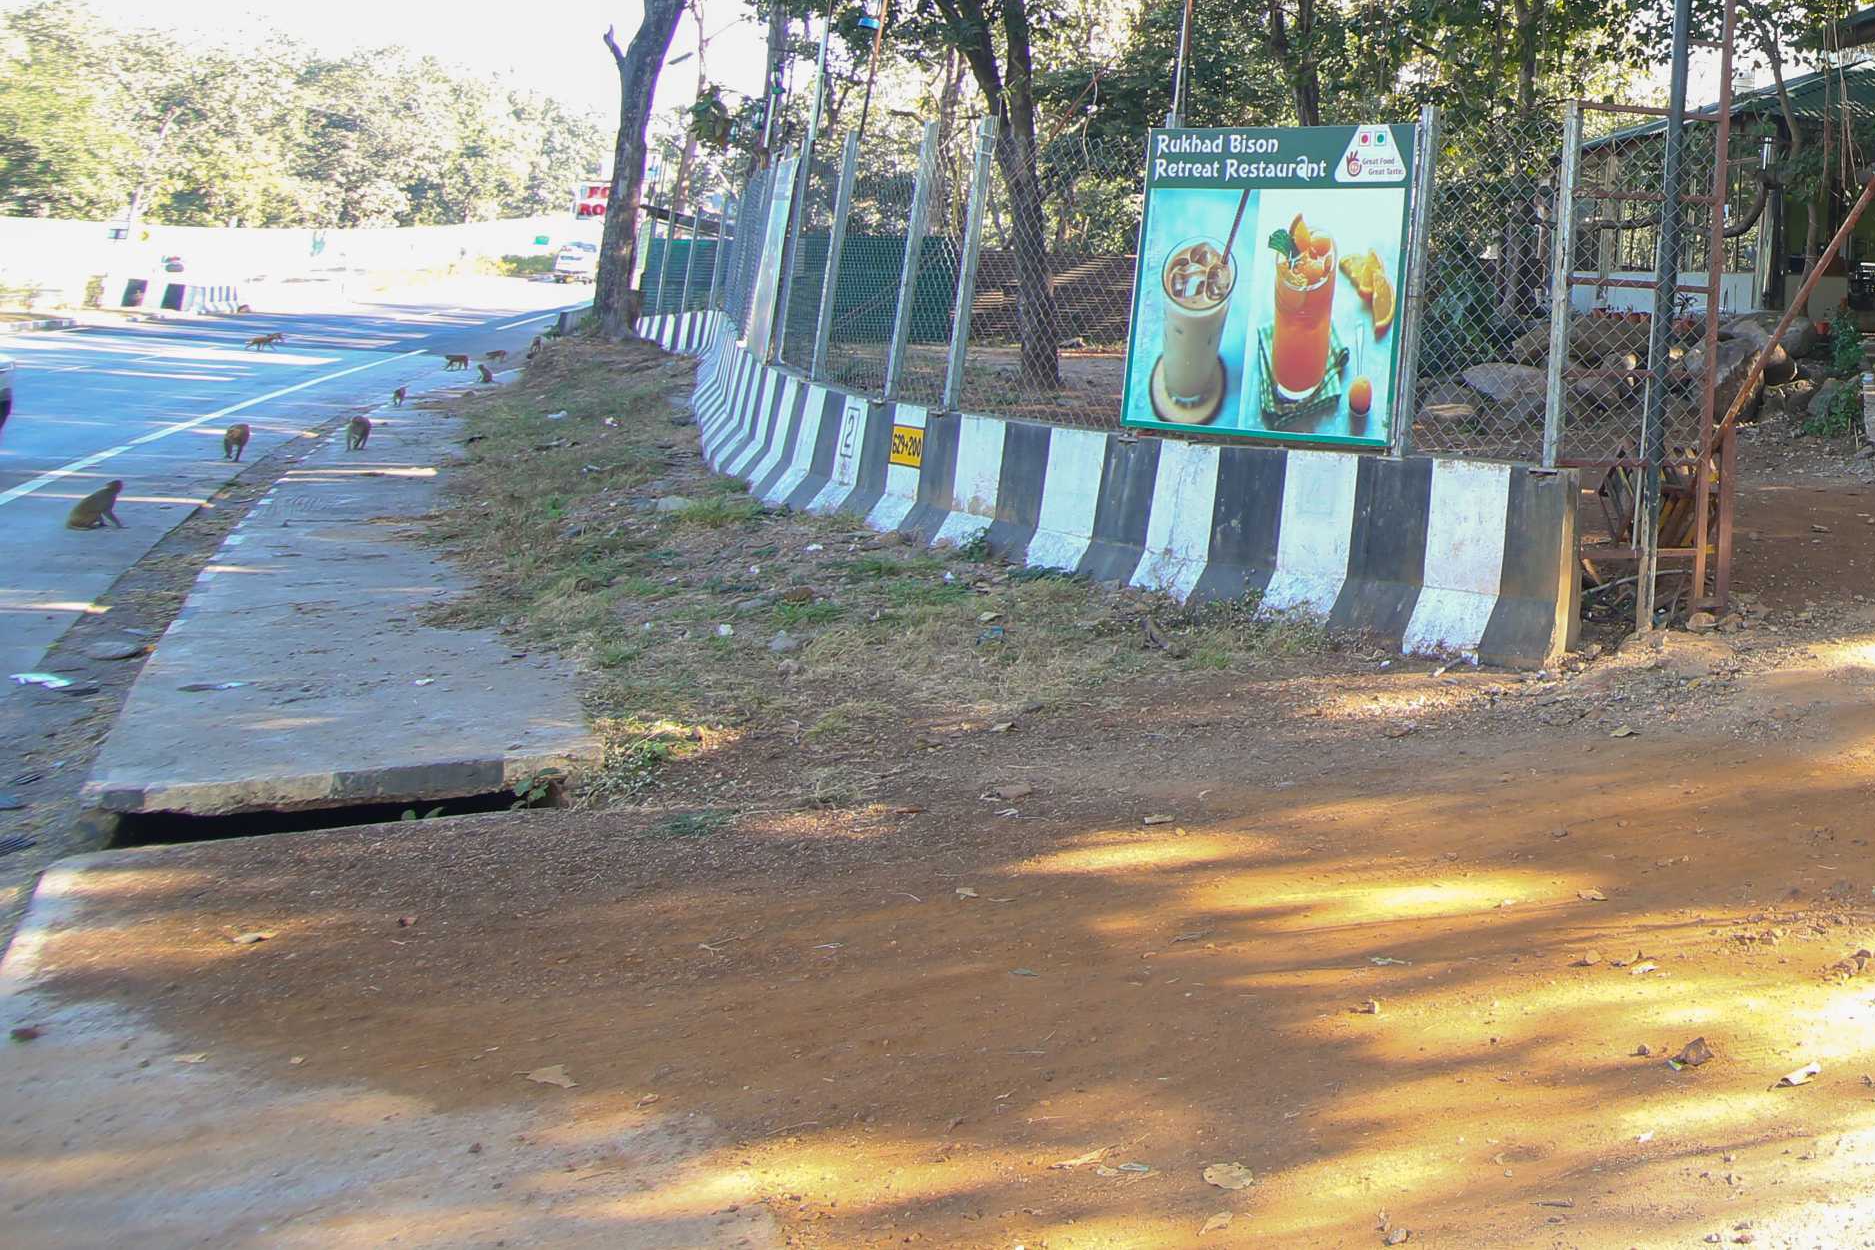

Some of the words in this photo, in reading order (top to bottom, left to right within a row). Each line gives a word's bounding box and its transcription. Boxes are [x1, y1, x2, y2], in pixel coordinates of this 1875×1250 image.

[1157, 134, 1223, 157] Rukhad
[1229, 134, 1279, 154] Bison
[1154, 158, 1219, 182] Retreat
[1225, 155, 1327, 182] Restaurant
[1361, 158, 1379, 166] Great
[1379, 157, 1395, 165] Food
